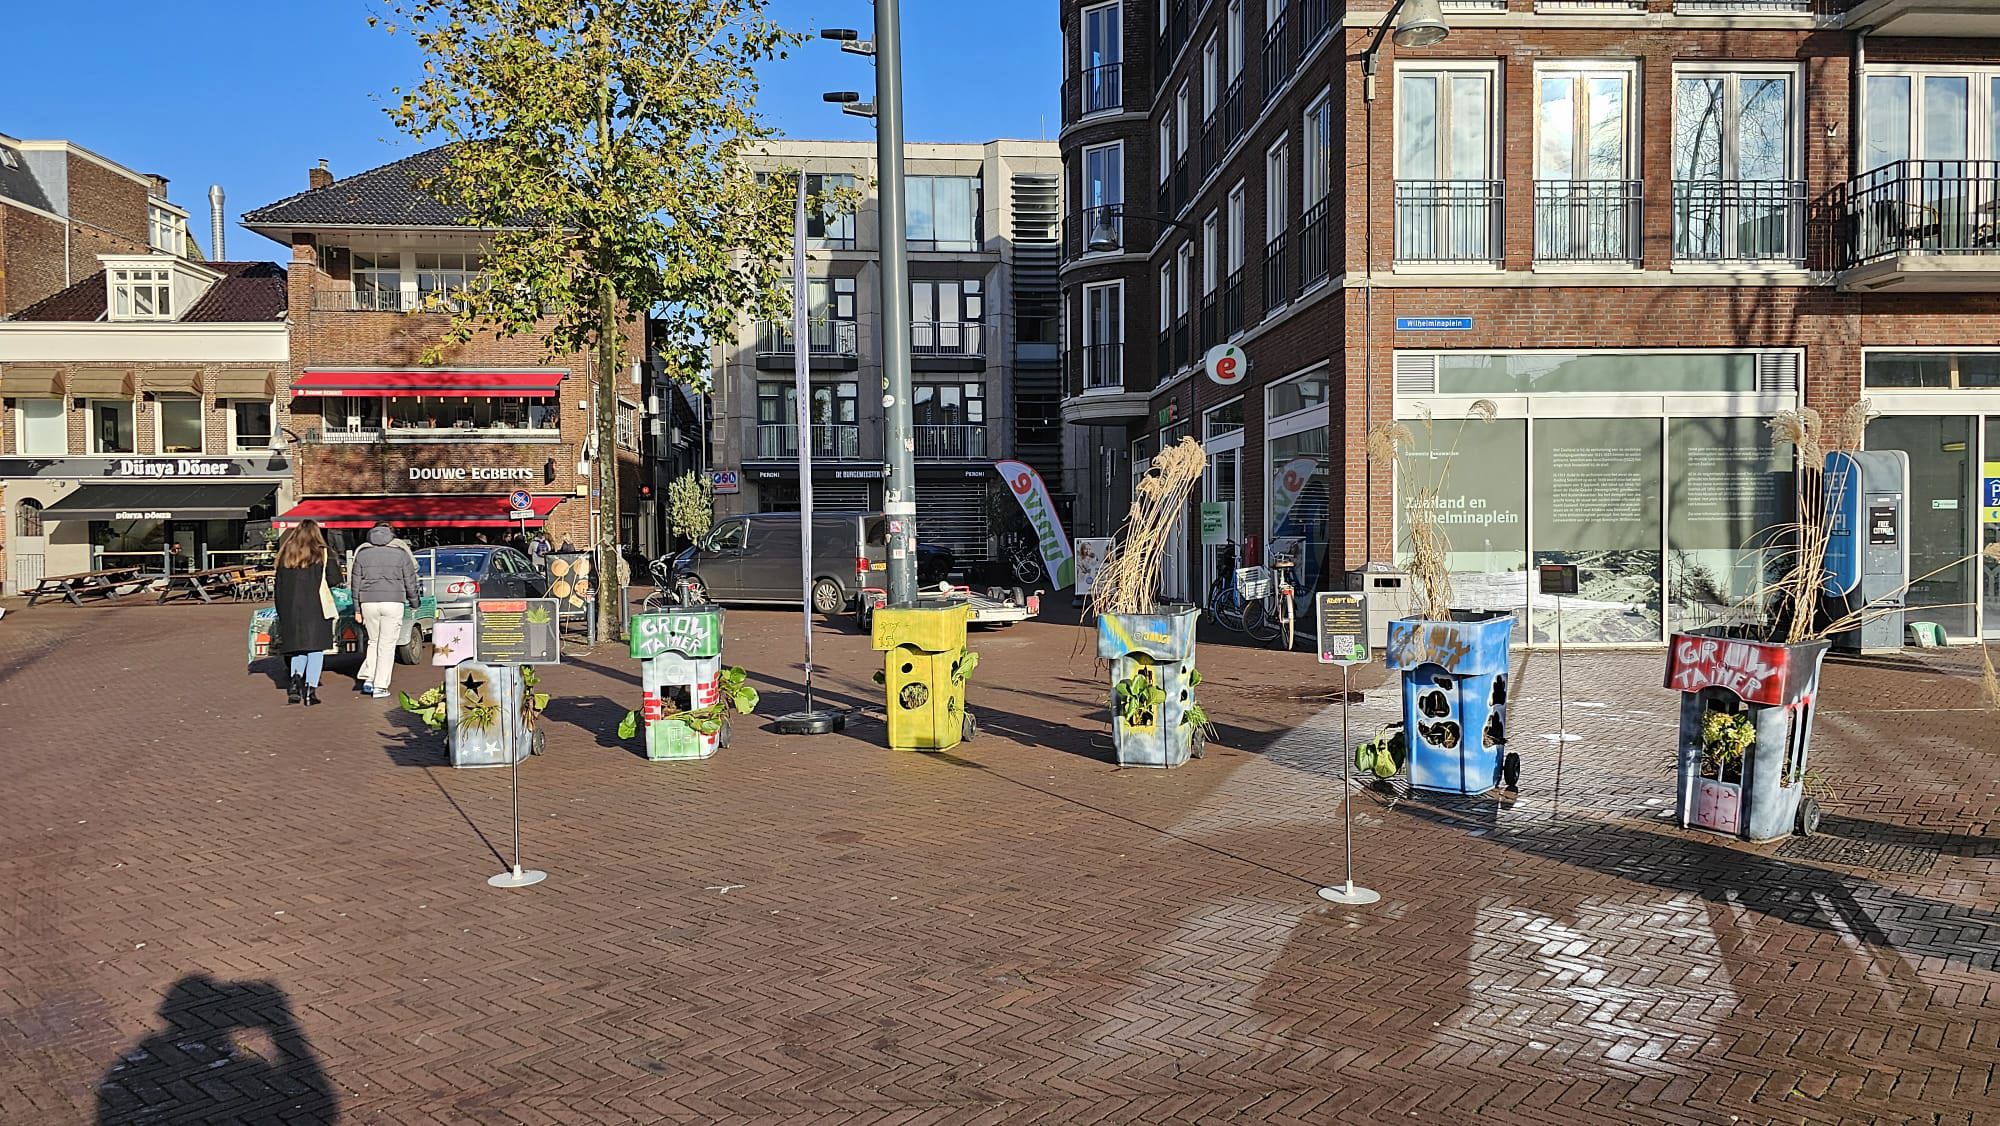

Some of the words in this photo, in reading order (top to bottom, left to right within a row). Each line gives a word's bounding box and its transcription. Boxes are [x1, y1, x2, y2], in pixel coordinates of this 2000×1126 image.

[1407, 320, 1463, 328] Wilhelminaplein
[120, 459, 174, 479] Dünya
[177, 459, 229, 475] Döner
[471, 467, 534, 480] EGBERTS
[1469, 499, 1487, 508] en
[641, 616, 710, 640] GROW
[1678, 640, 1778, 680] GROW
